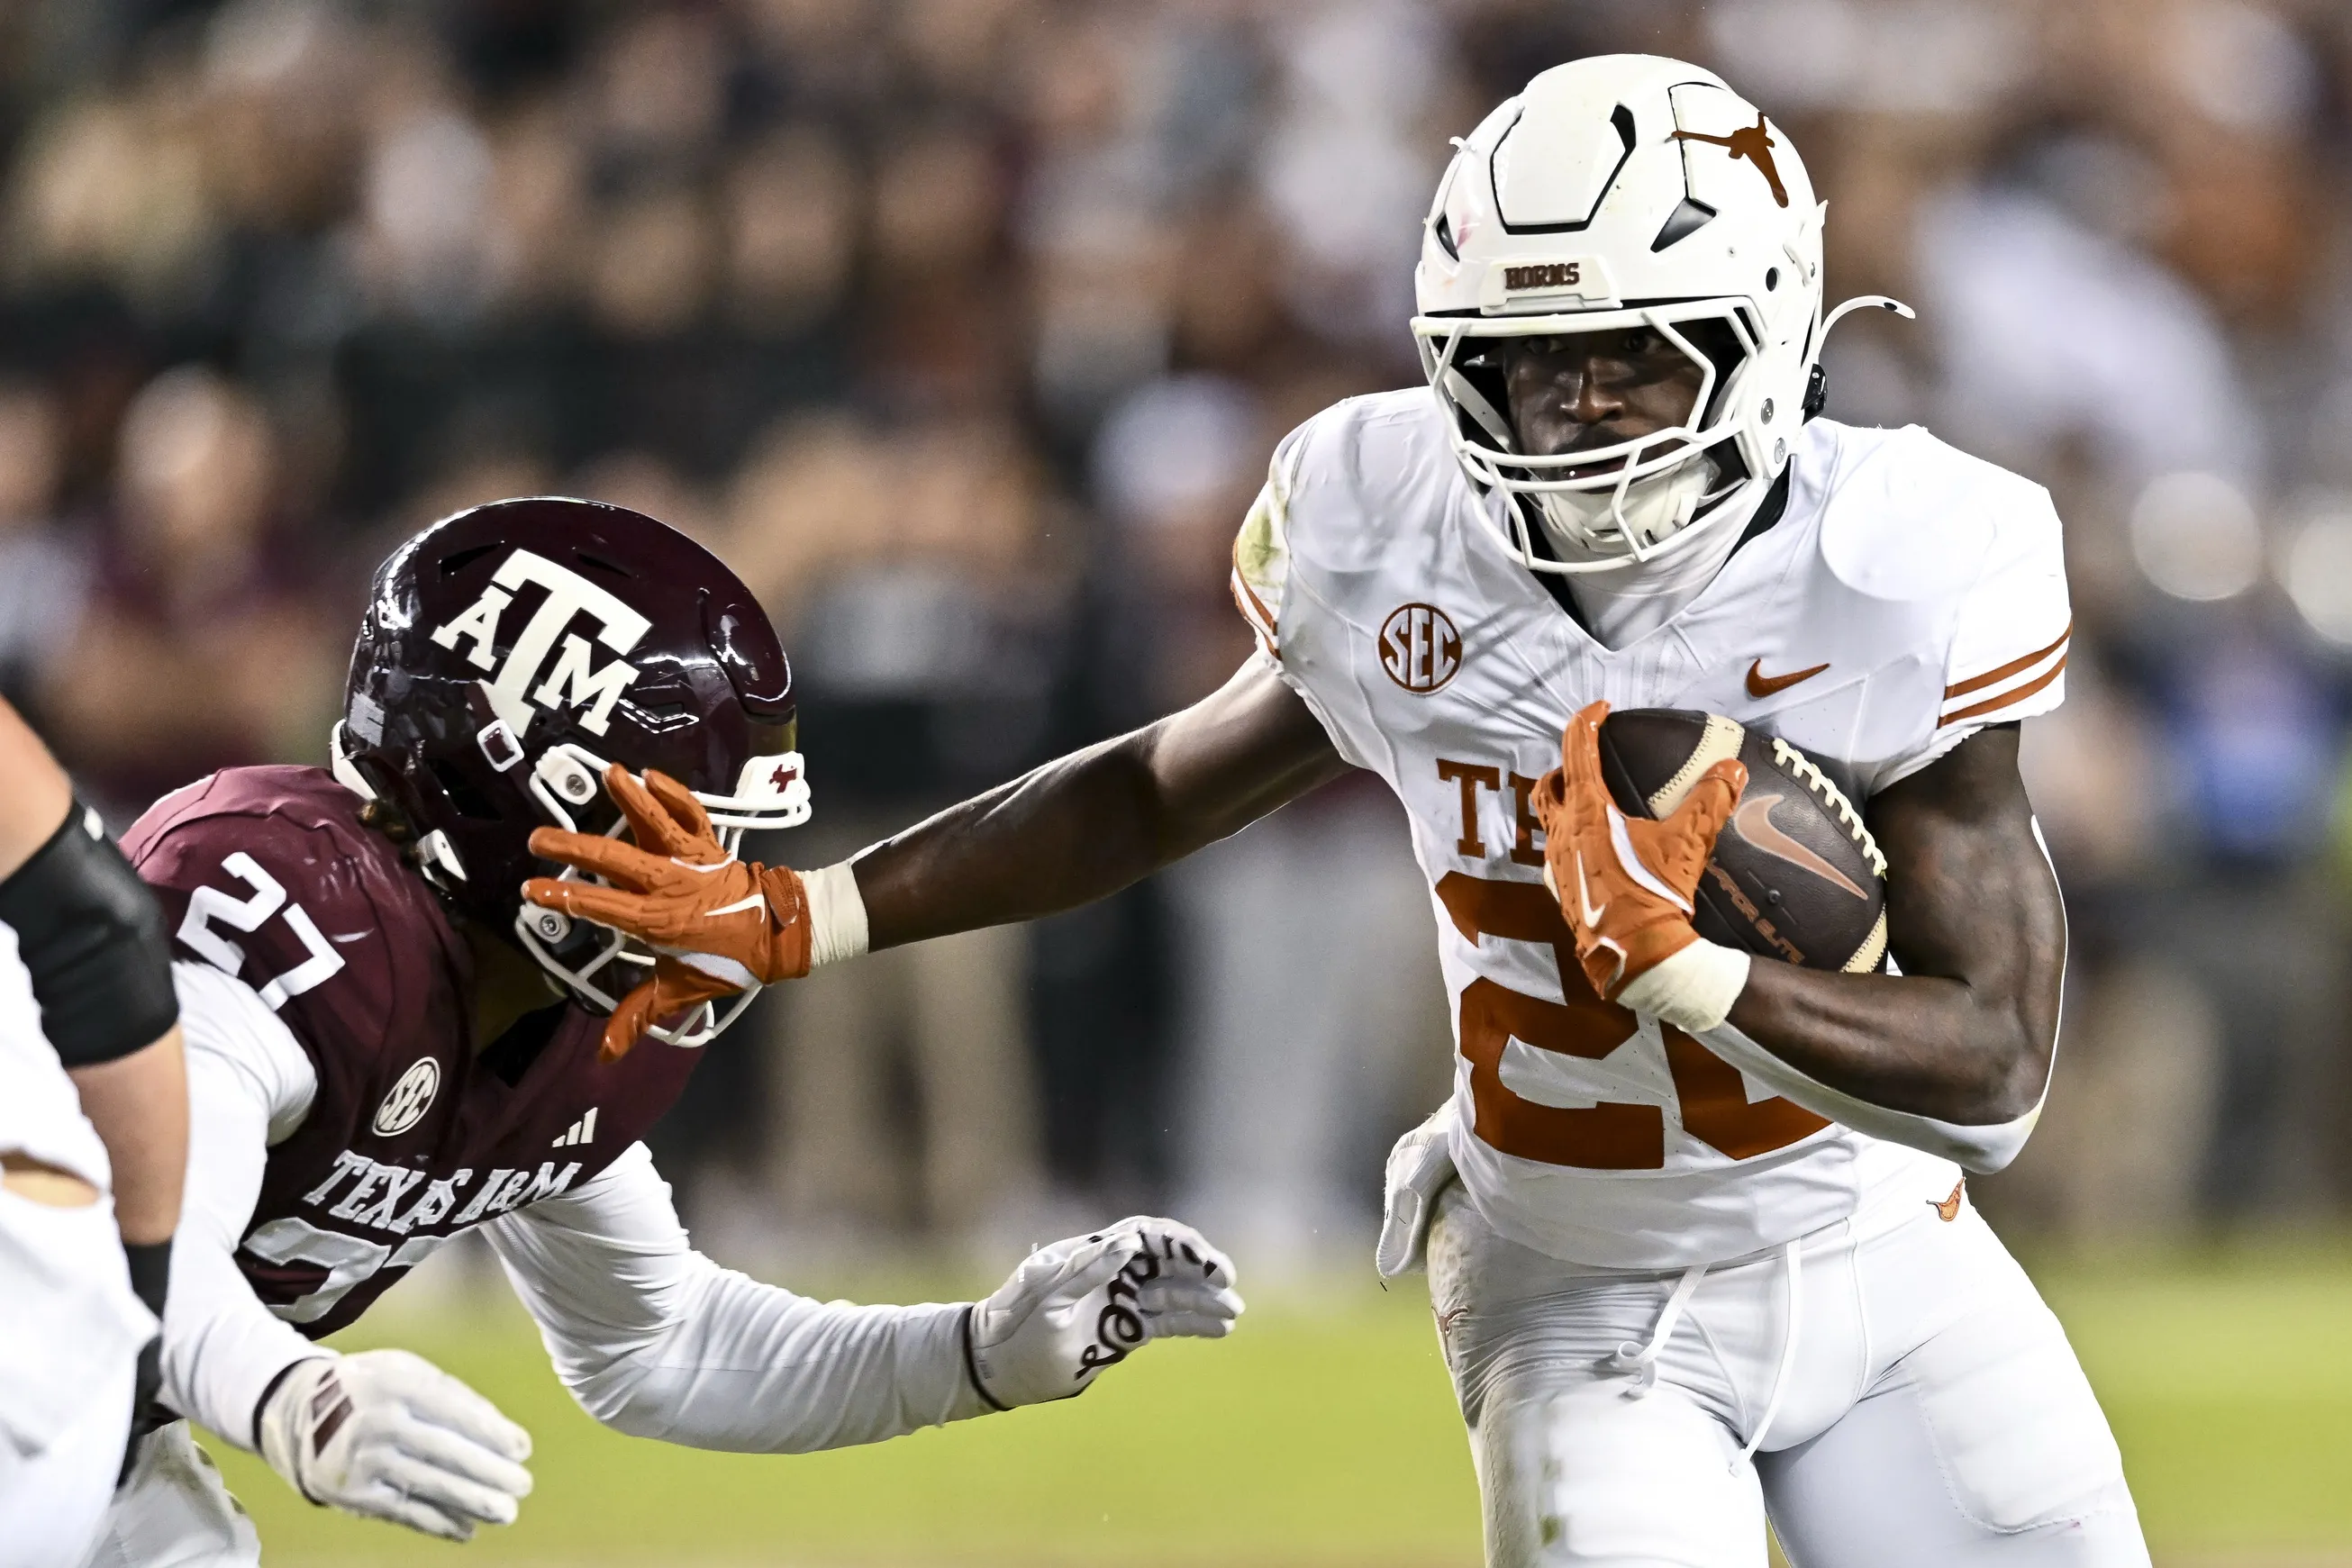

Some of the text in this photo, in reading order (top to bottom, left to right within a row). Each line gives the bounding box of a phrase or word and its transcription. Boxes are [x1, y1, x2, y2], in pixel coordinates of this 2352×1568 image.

[1504, 263, 1580, 289] HORNS
[1383, 607, 1457, 688] SEC
[177, 851, 345, 1012] 27
[377, 1063, 436, 1131] SEC
[302, 1149, 473, 1236] TEXAS
